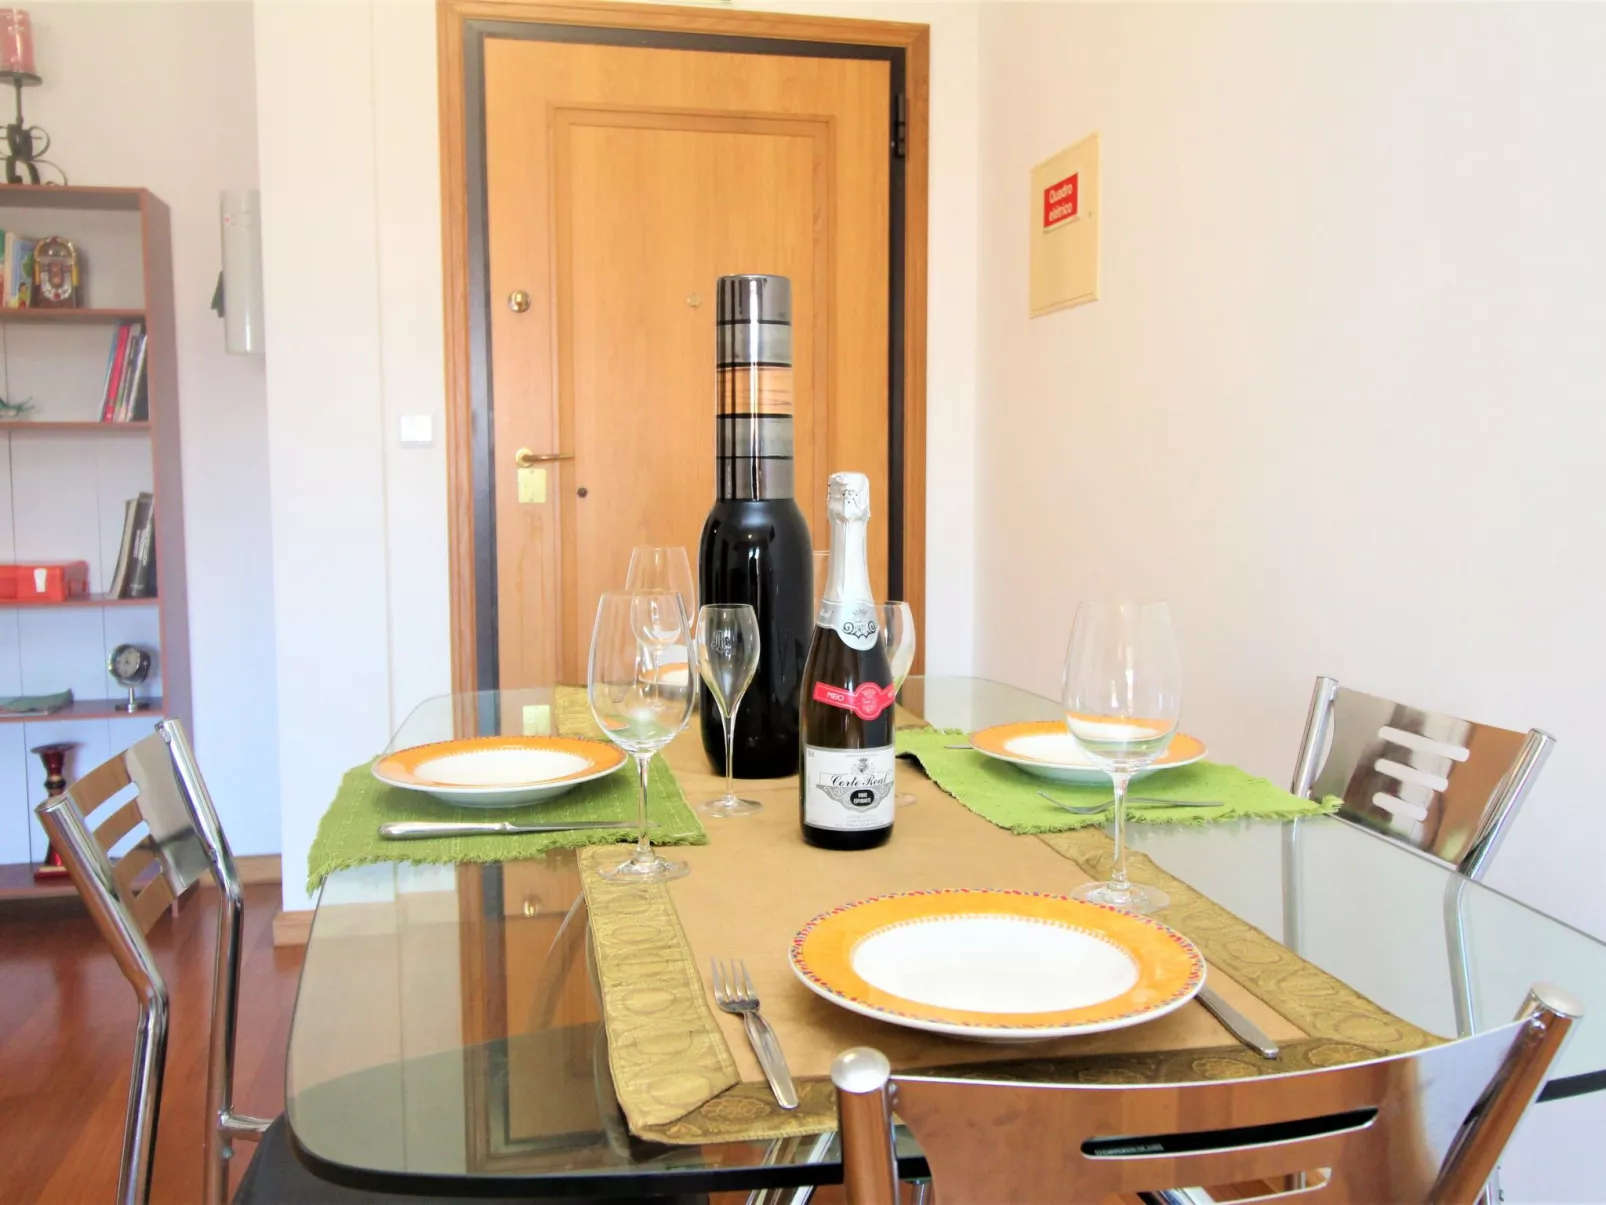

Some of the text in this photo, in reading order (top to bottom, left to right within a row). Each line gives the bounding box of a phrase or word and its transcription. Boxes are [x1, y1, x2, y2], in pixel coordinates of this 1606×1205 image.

[1049, 184, 1073, 203] Quadro
[1048, 203, 1073, 222] elétrico
[826, 691, 845, 702] MEIO
[830, 773, 888, 787] Corte Real
